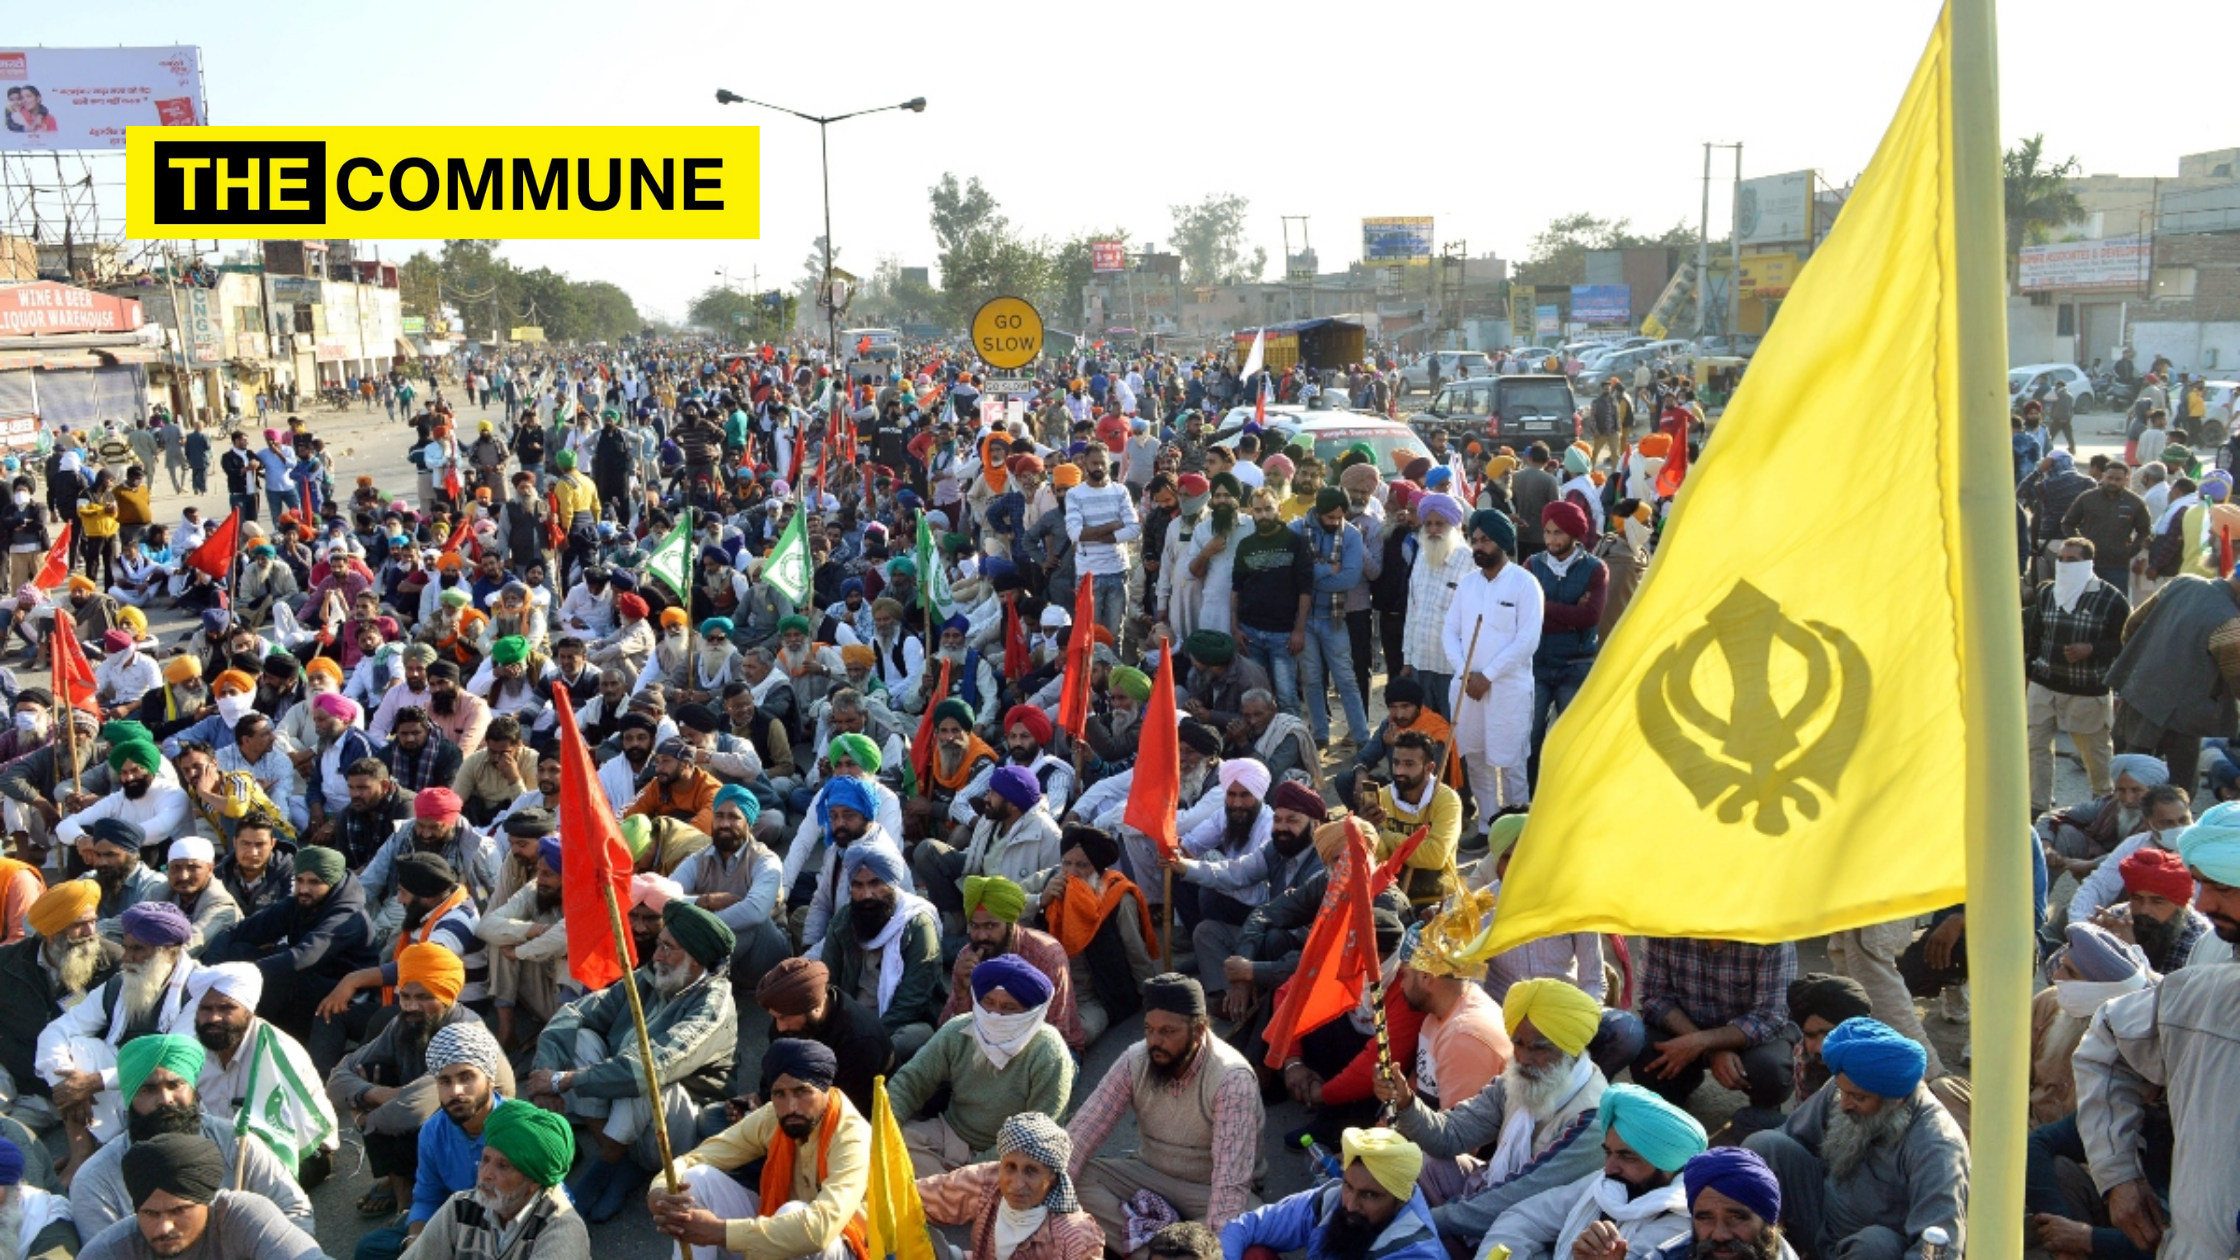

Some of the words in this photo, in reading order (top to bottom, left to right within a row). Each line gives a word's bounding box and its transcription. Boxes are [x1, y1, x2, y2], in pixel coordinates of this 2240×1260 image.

[18, 289, 52, 307] WINE
[54, 289, 64, 309] &
[65, 290, 93, 309] BEER
[192, 288, 209, 332] CNG
[46, 309, 115, 328] WAREHOUSE
[995, 315, 1022, 329] GO
[983, 337, 1034, 351] SLOW
[986, 382, 999, 391] GO
[1002, 381, 1028, 391] SLOW
